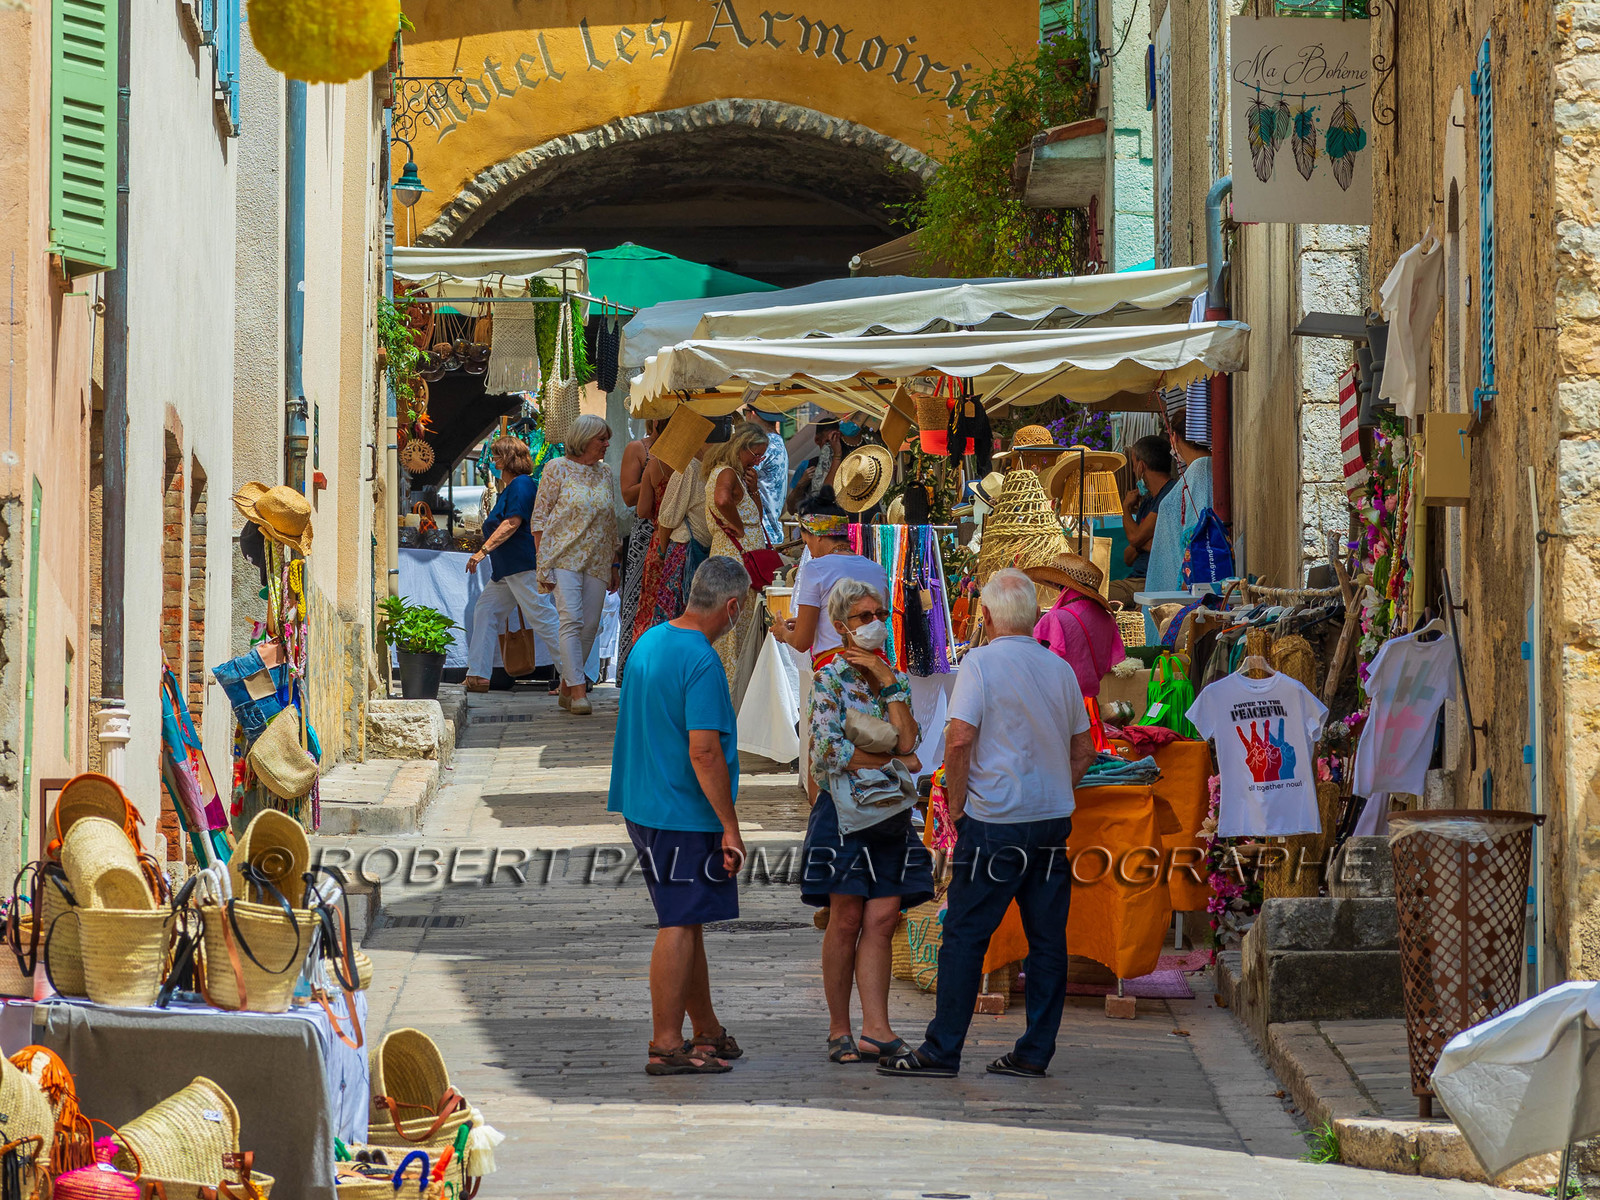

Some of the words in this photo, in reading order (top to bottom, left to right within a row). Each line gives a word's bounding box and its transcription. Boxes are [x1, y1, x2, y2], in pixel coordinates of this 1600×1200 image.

[578, 16, 673, 72] les
[1233, 45, 1283, 86] Ma
[1283, 43, 1369, 85] Bohème
[1230, 706, 1288, 721] PEACEFUL
[1256, 782, 1284, 792] together
